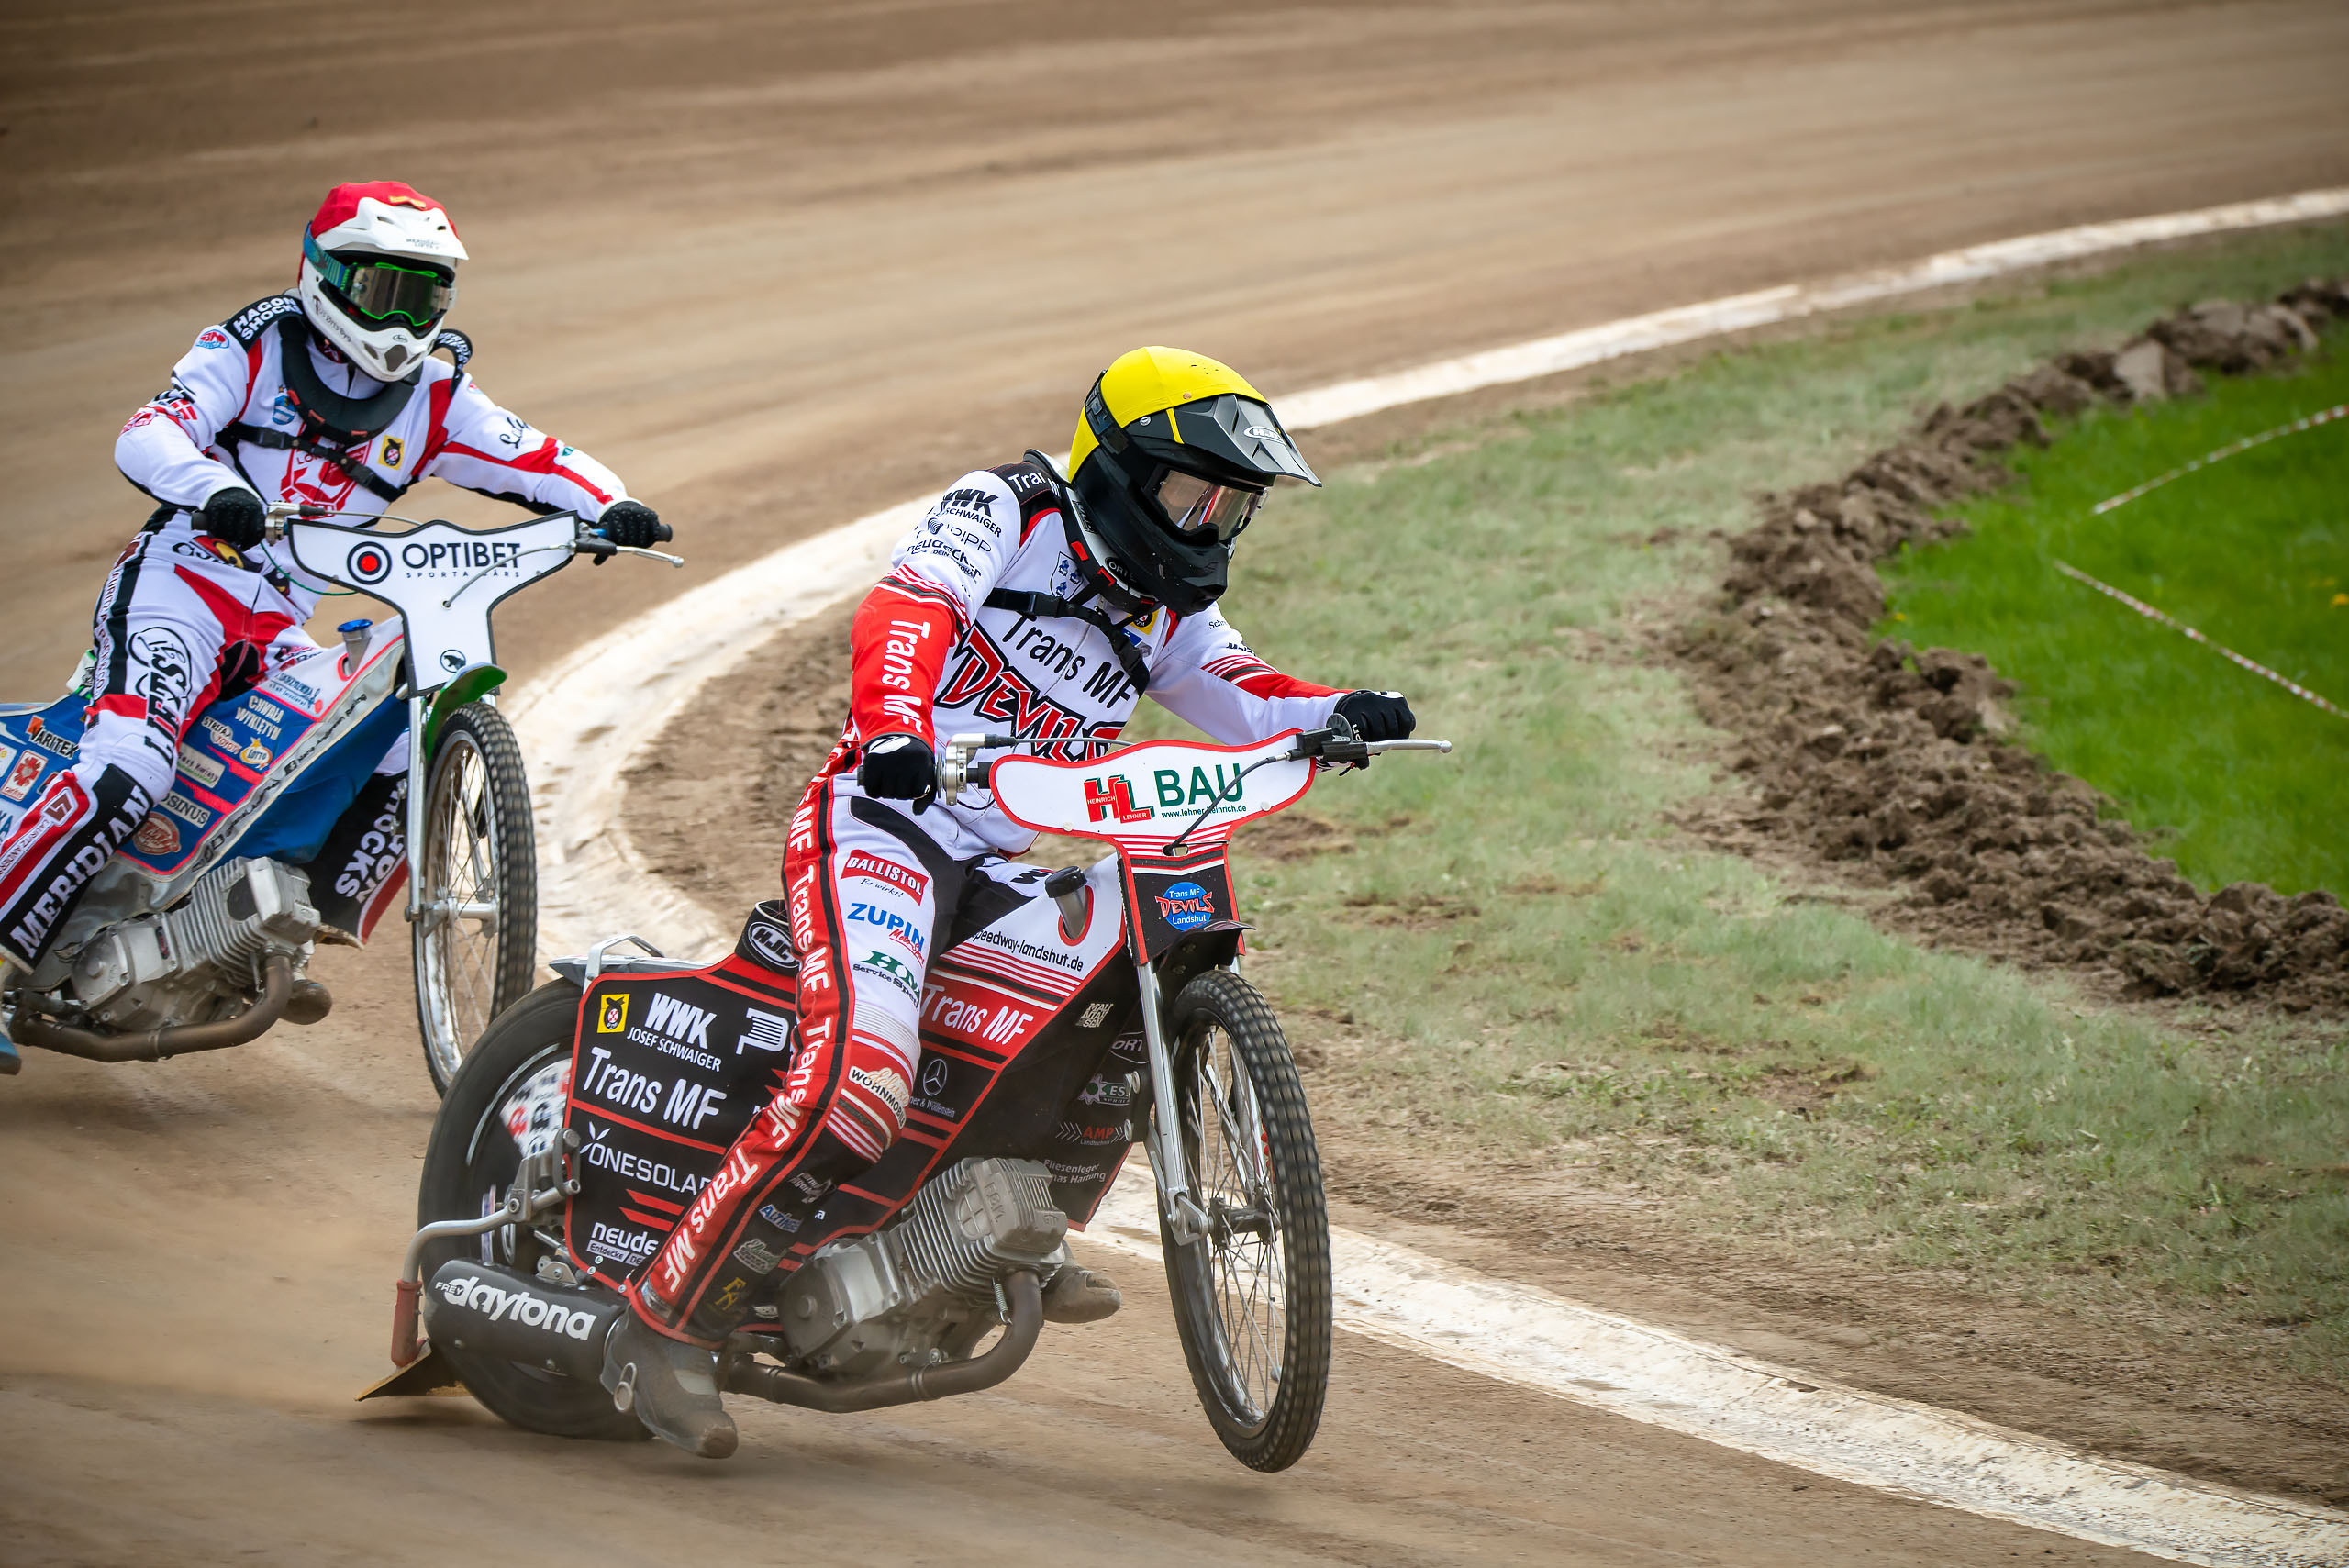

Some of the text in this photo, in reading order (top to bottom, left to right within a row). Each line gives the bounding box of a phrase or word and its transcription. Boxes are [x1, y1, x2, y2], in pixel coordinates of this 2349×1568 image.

[233, 297, 297, 333] HAGON
[241, 304, 303, 340] SHOCKS
[402, 542, 520, 569] OPTIBET
[882, 620, 930, 733] Trans MF
[1002, 613, 1131, 708] Trans MF
[30, 726, 79, 759] VARITEX
[247, 749, 267, 760] LOTTO
[1087, 795, 1116, 805] HEINRICH
[1153, 763, 1243, 807] BAU
[790, 806, 813, 851] MF
[1122, 812, 1147, 821] LEHNER
[10, 785, 153, 959] MERIDIAN
[846, 857, 922, 895] BALLISTOL
[875, 884, 904, 897] wirkt!
[1154, 891, 1215, 917] DEVILS
[1169, 890, 1188, 898] Trans
[792, 864, 829, 992] Trans MF
[847, 903, 925, 951] ZUPIN
[1173, 914, 1206, 924] Landshut
[753, 927, 792, 961] HJC
[973, 930, 1084, 972] peedway-landshut.de
[853, 963, 892, 983] Service
[644, 992, 718, 1050] WWK
[919, 983, 1034, 1045] Trans MF
[627, 1027, 722, 1073] JOSEF SCHWAIGER
[583, 1046, 662, 1115] Trans
[662, 1078, 728, 1131] MF
[771, 1017, 831, 1149] Trans MF
[1084, 1126, 1115, 1140] AMP
[1044, 1159, 1100, 1175] Fliesenleger
[1070, 1173, 1106, 1184] Hartung
[690, 1147, 760, 1234] Trans
[589, 1244, 624, 1261] Entdecke
[591, 1222, 659, 1256] neude
[663, 1228, 697, 1294] MF
[435, 1282, 464, 1295] FREY
[444, 1276, 597, 1341] daytona
